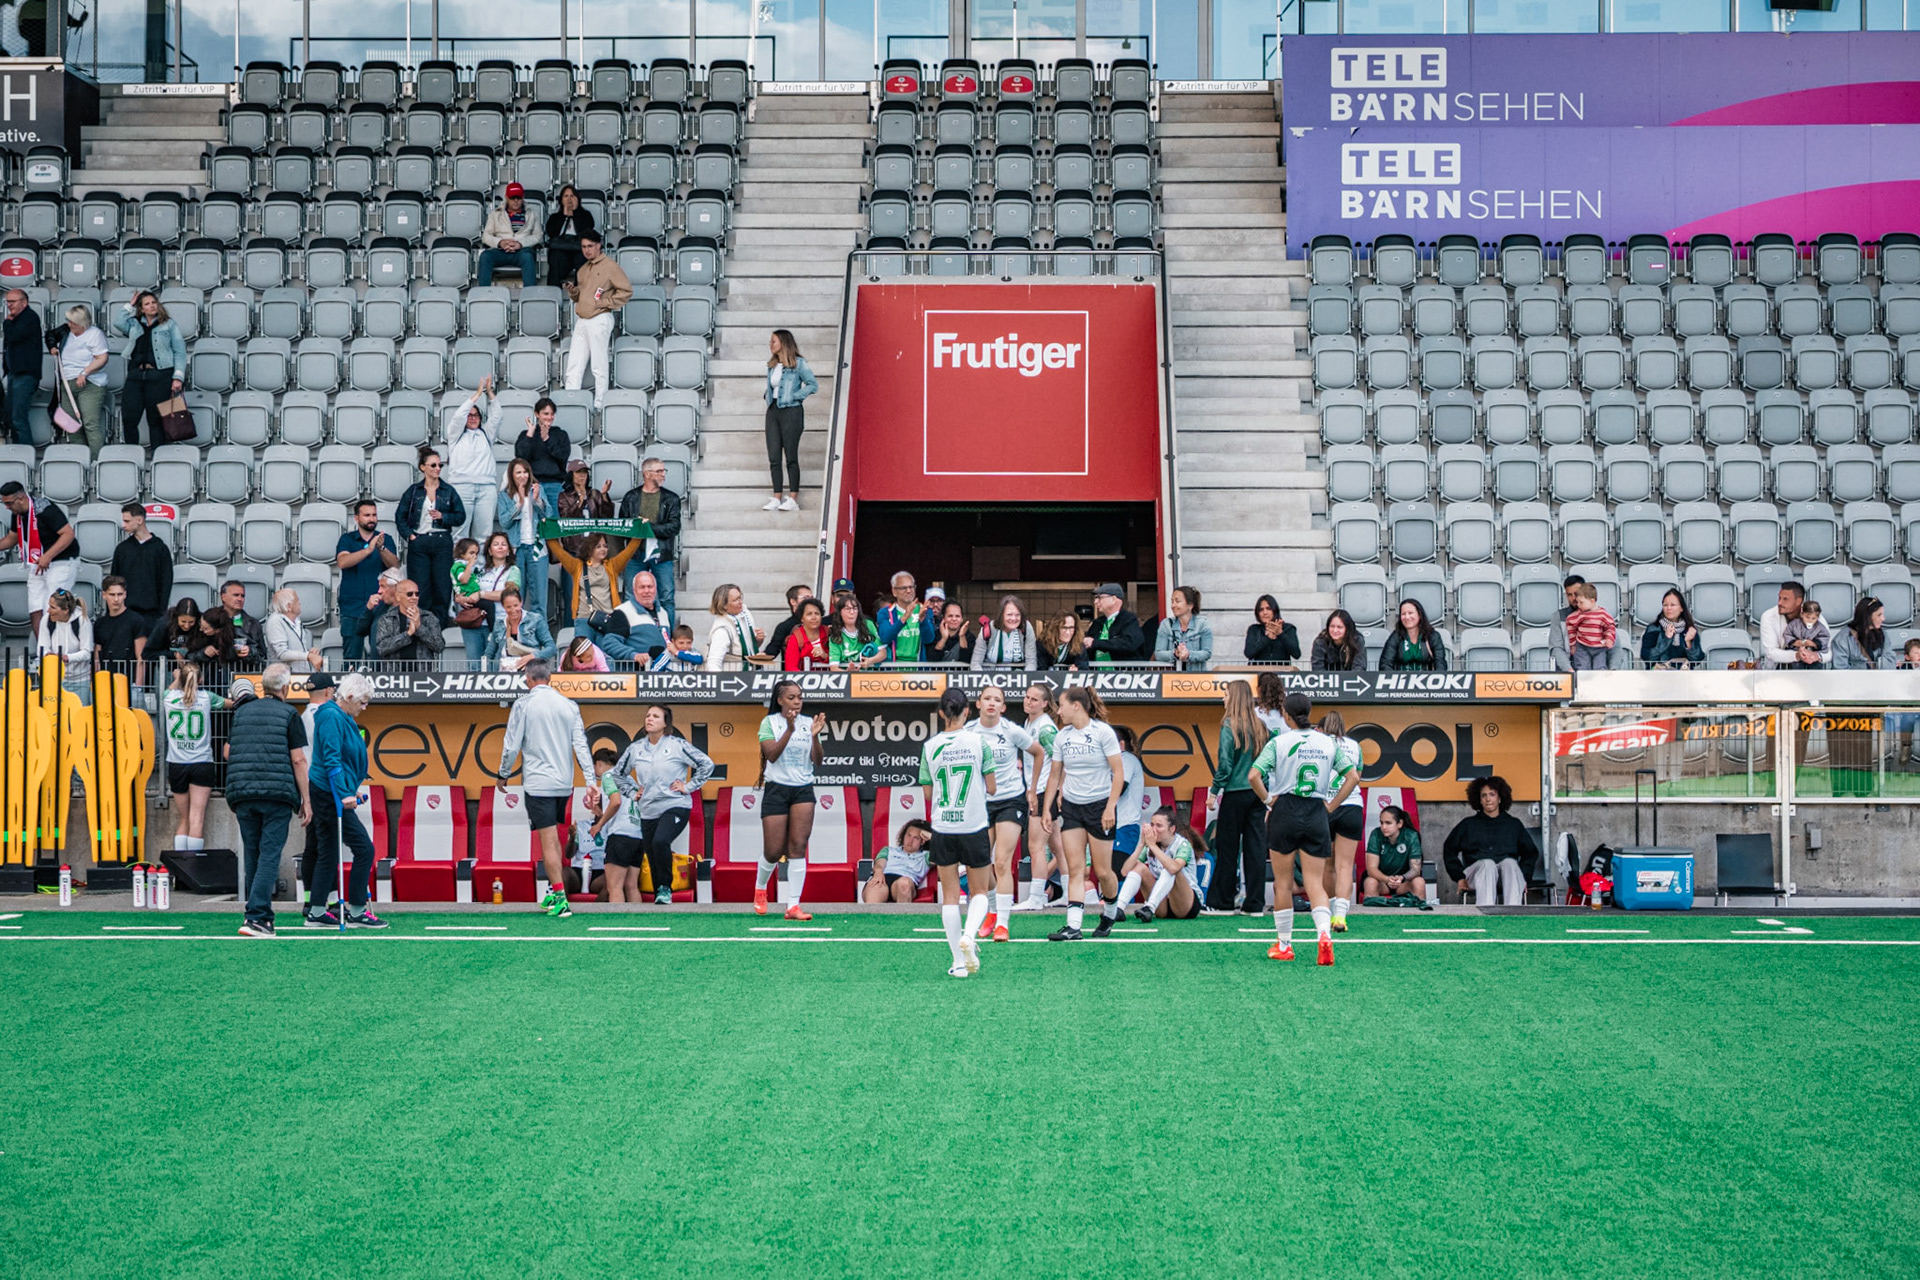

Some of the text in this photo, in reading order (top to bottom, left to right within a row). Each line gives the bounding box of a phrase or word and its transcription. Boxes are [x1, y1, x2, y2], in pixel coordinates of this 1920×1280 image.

[1337, 53, 1440, 81] TELE
[133, 85, 162, 94] Zutritt
[166, 86, 181, 94] nur
[184, 85, 198, 93] für
[773, 83, 803, 92] Zutritt
[824, 83, 837, 92] für
[1175, 82, 1205, 90] Zutritt
[1226, 81, 1240, 90] für
[1242, 82, 1259, 90] VIP
[1348, 150, 1454, 178] TELE
[933, 332, 1081, 377] Frutiger
[442, 674, 530, 690] HiKOK
[638, 674, 717, 689] HITACHI
[949, 674, 1027, 688] HITACHI
[1279, 674, 1340, 689] TACHI
[168, 710, 204, 740] 20
[819, 712, 938, 742] evotool
[871, 774, 908, 783] SIHGA
[935, 762, 974, 808] 17
[1295, 762, 1320, 797] 6
[941, 811, 964, 822] GUEDE
